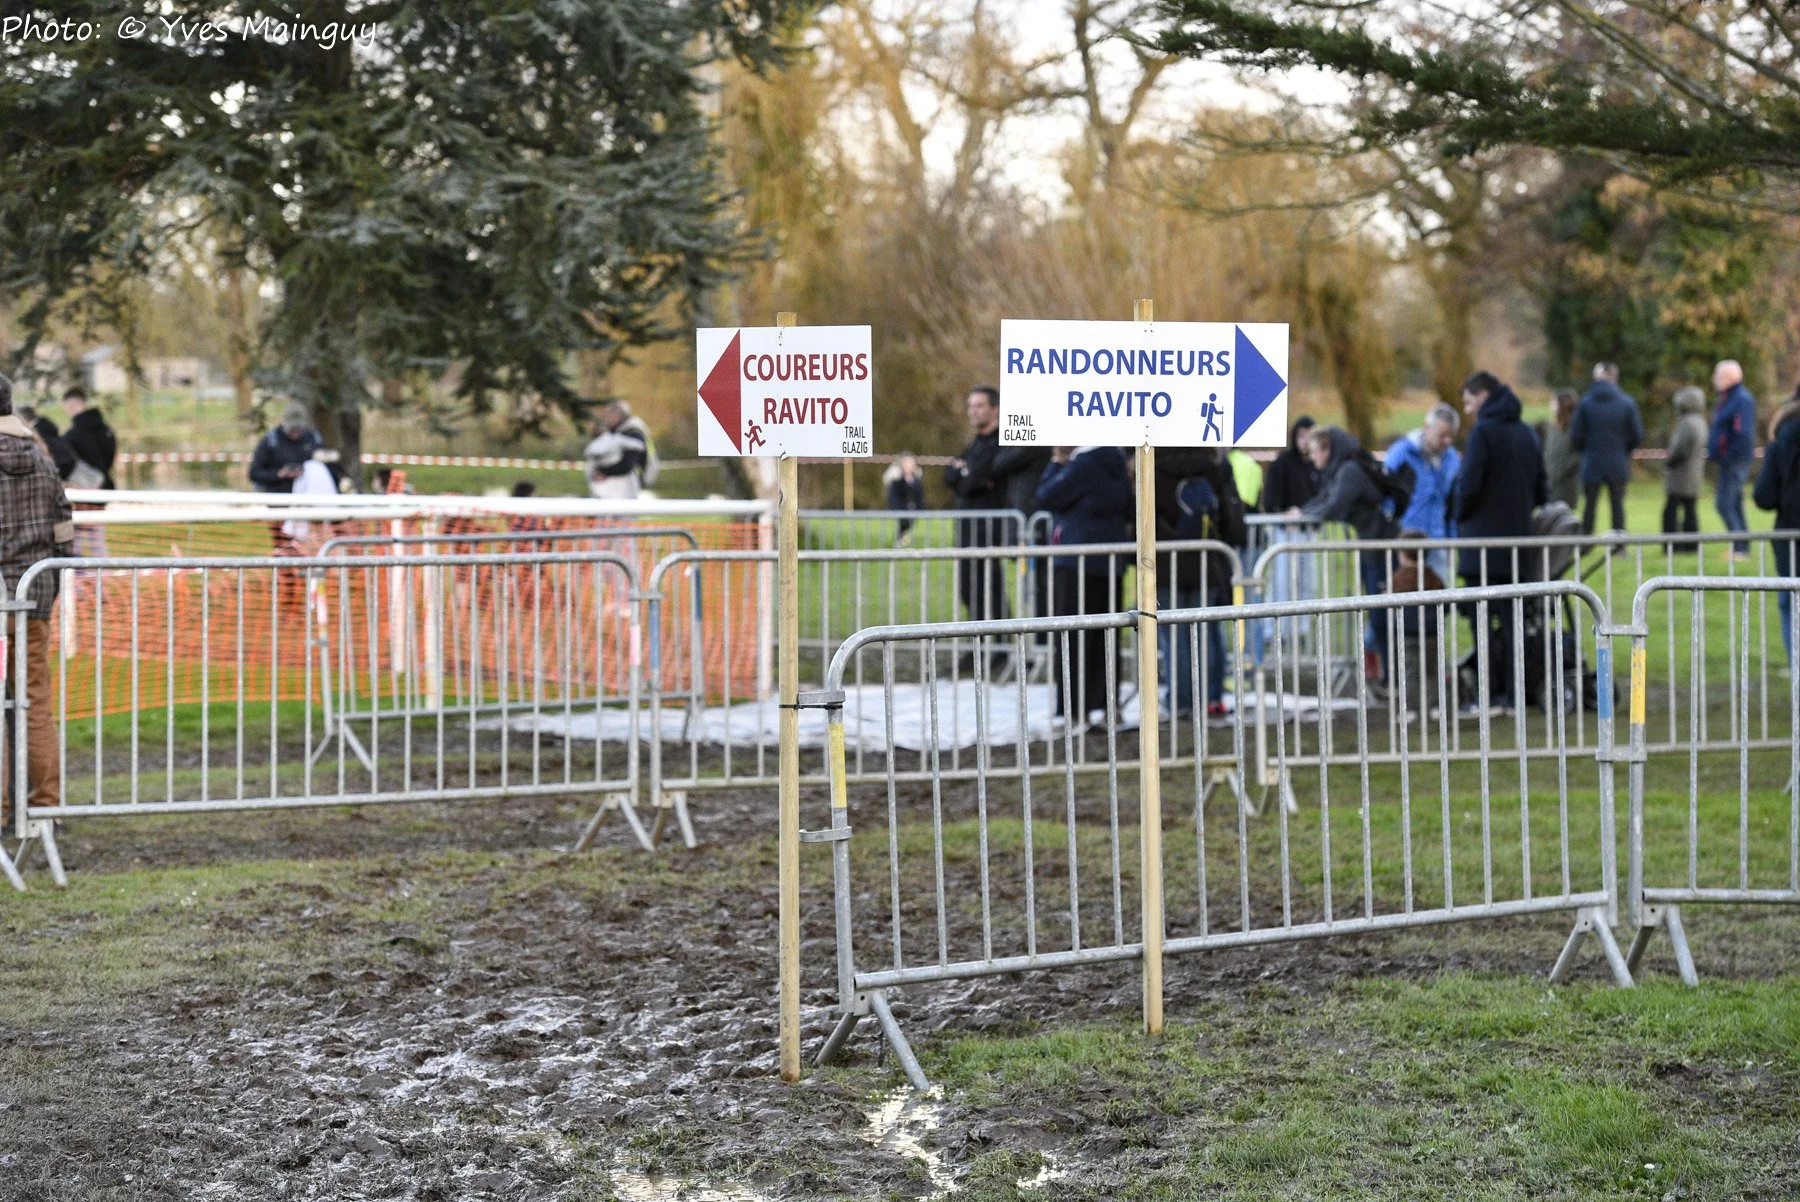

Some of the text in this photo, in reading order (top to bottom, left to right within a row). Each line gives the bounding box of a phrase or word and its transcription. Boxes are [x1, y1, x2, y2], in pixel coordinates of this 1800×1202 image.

[743, 353, 868, 382] COUREURS
[1007, 347, 1231, 377] RANDONNEURS
[763, 397, 849, 425] RAVITO
[1067, 390, 1172, 418] RAVITO
[1007, 414, 1034, 427] TRAIL
[844, 426, 866, 439] TRAIL
[1004, 429, 1036, 441] GLAZIG
[842, 441, 868, 454] GLAZIG
